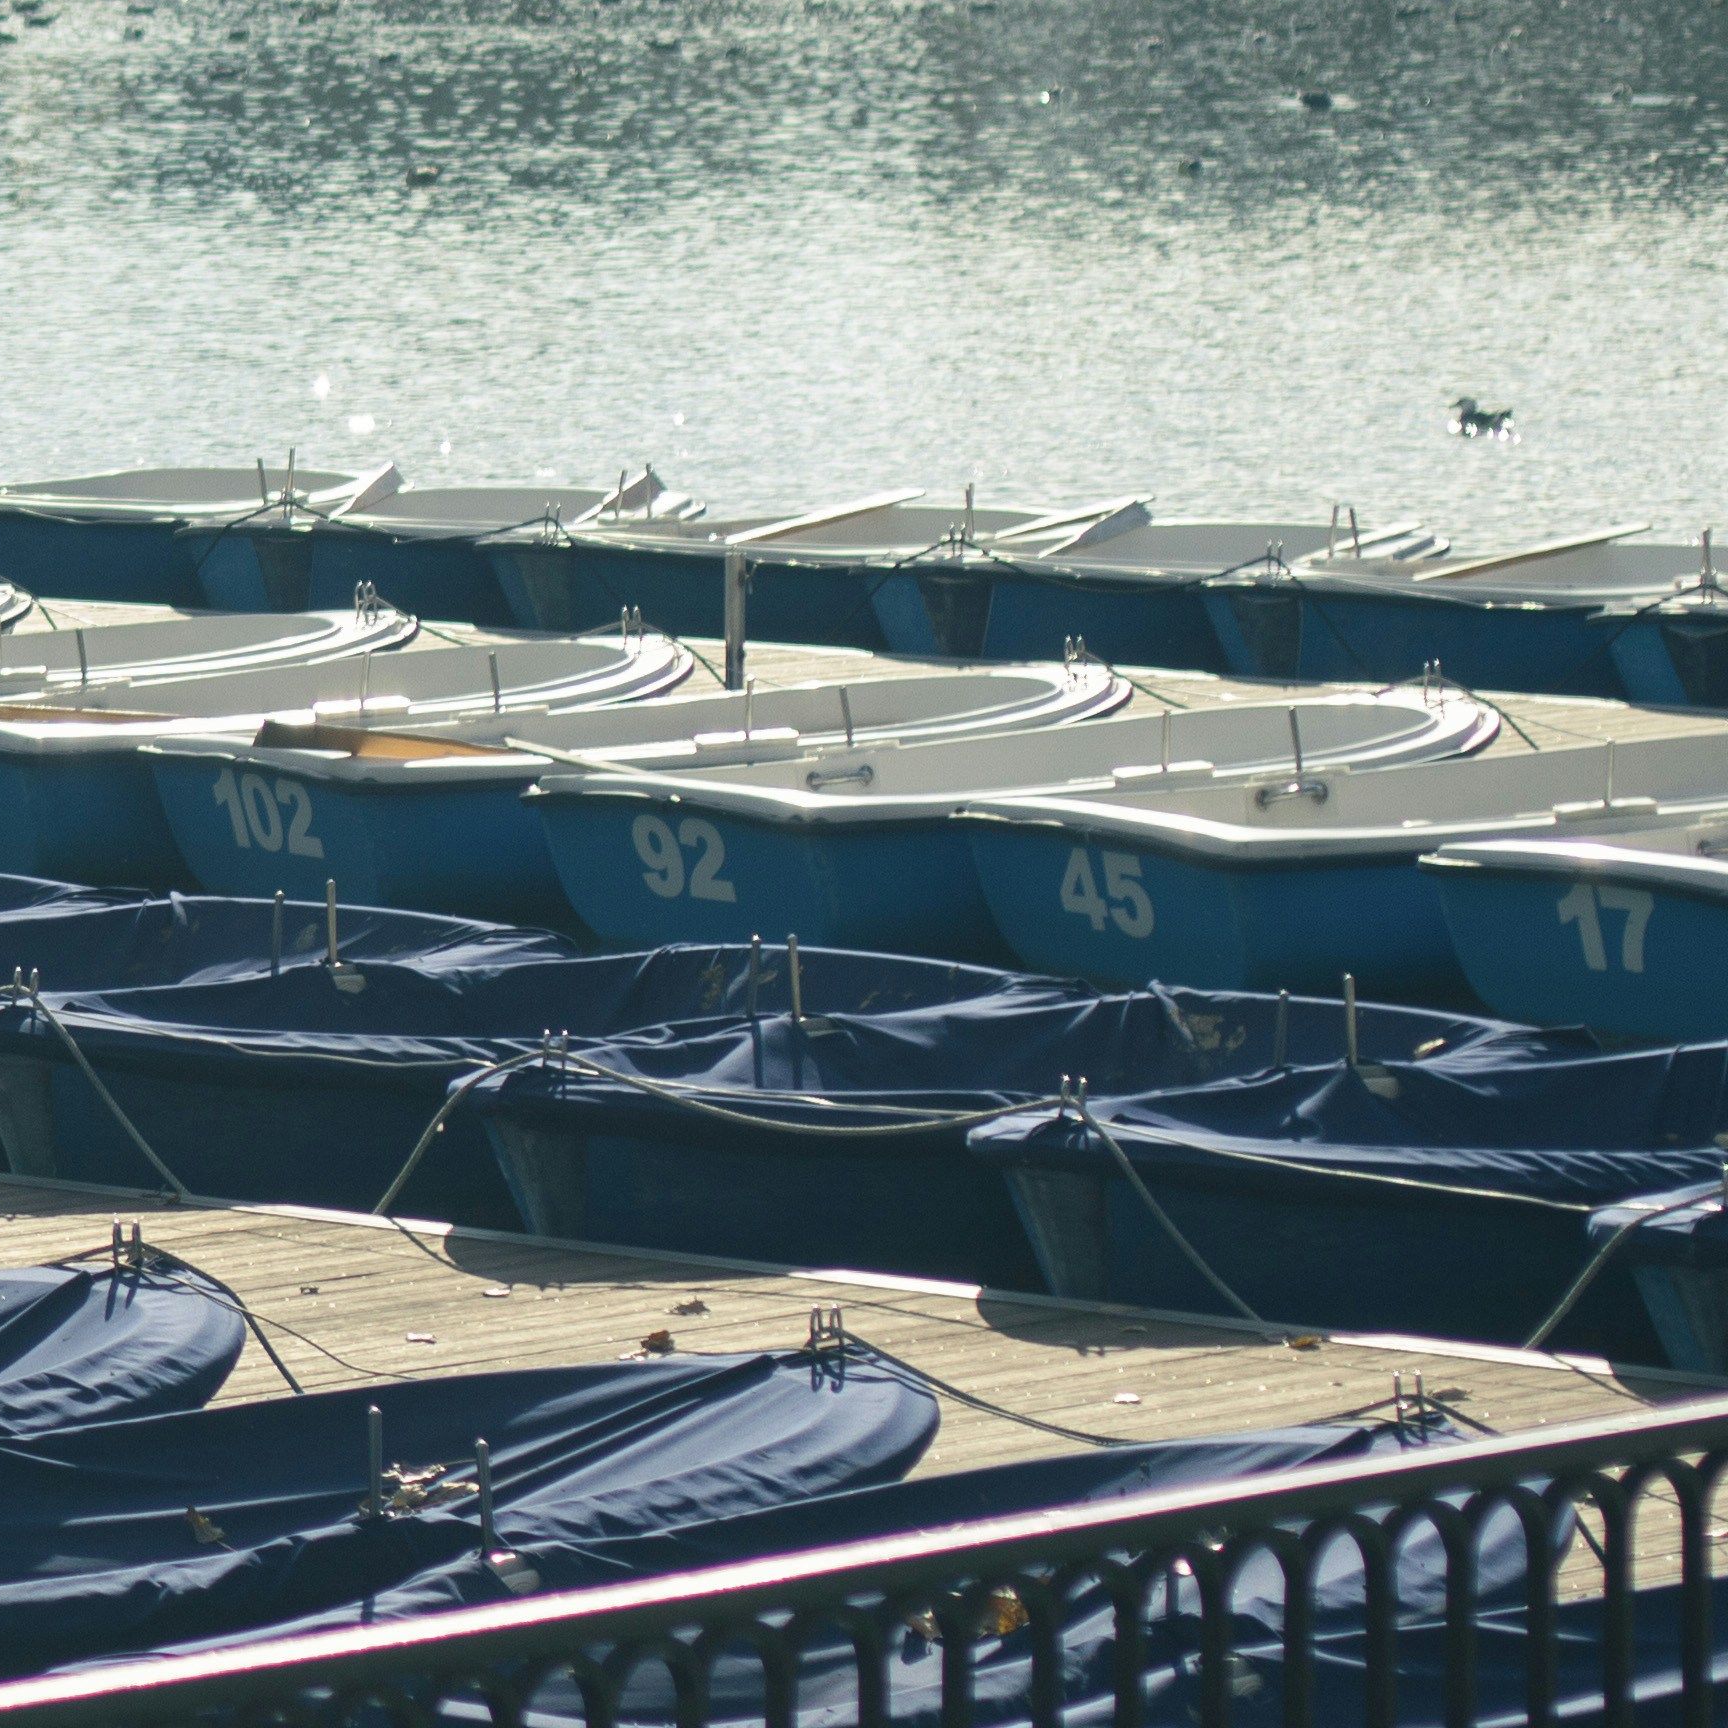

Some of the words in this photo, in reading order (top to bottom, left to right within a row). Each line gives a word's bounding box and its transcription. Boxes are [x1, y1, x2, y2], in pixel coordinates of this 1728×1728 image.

[213, 768, 325, 859] 102
[631, 814, 737, 903] 92
[1060, 848, 1155, 939] 45
[1557, 883, 1654, 974] 17
